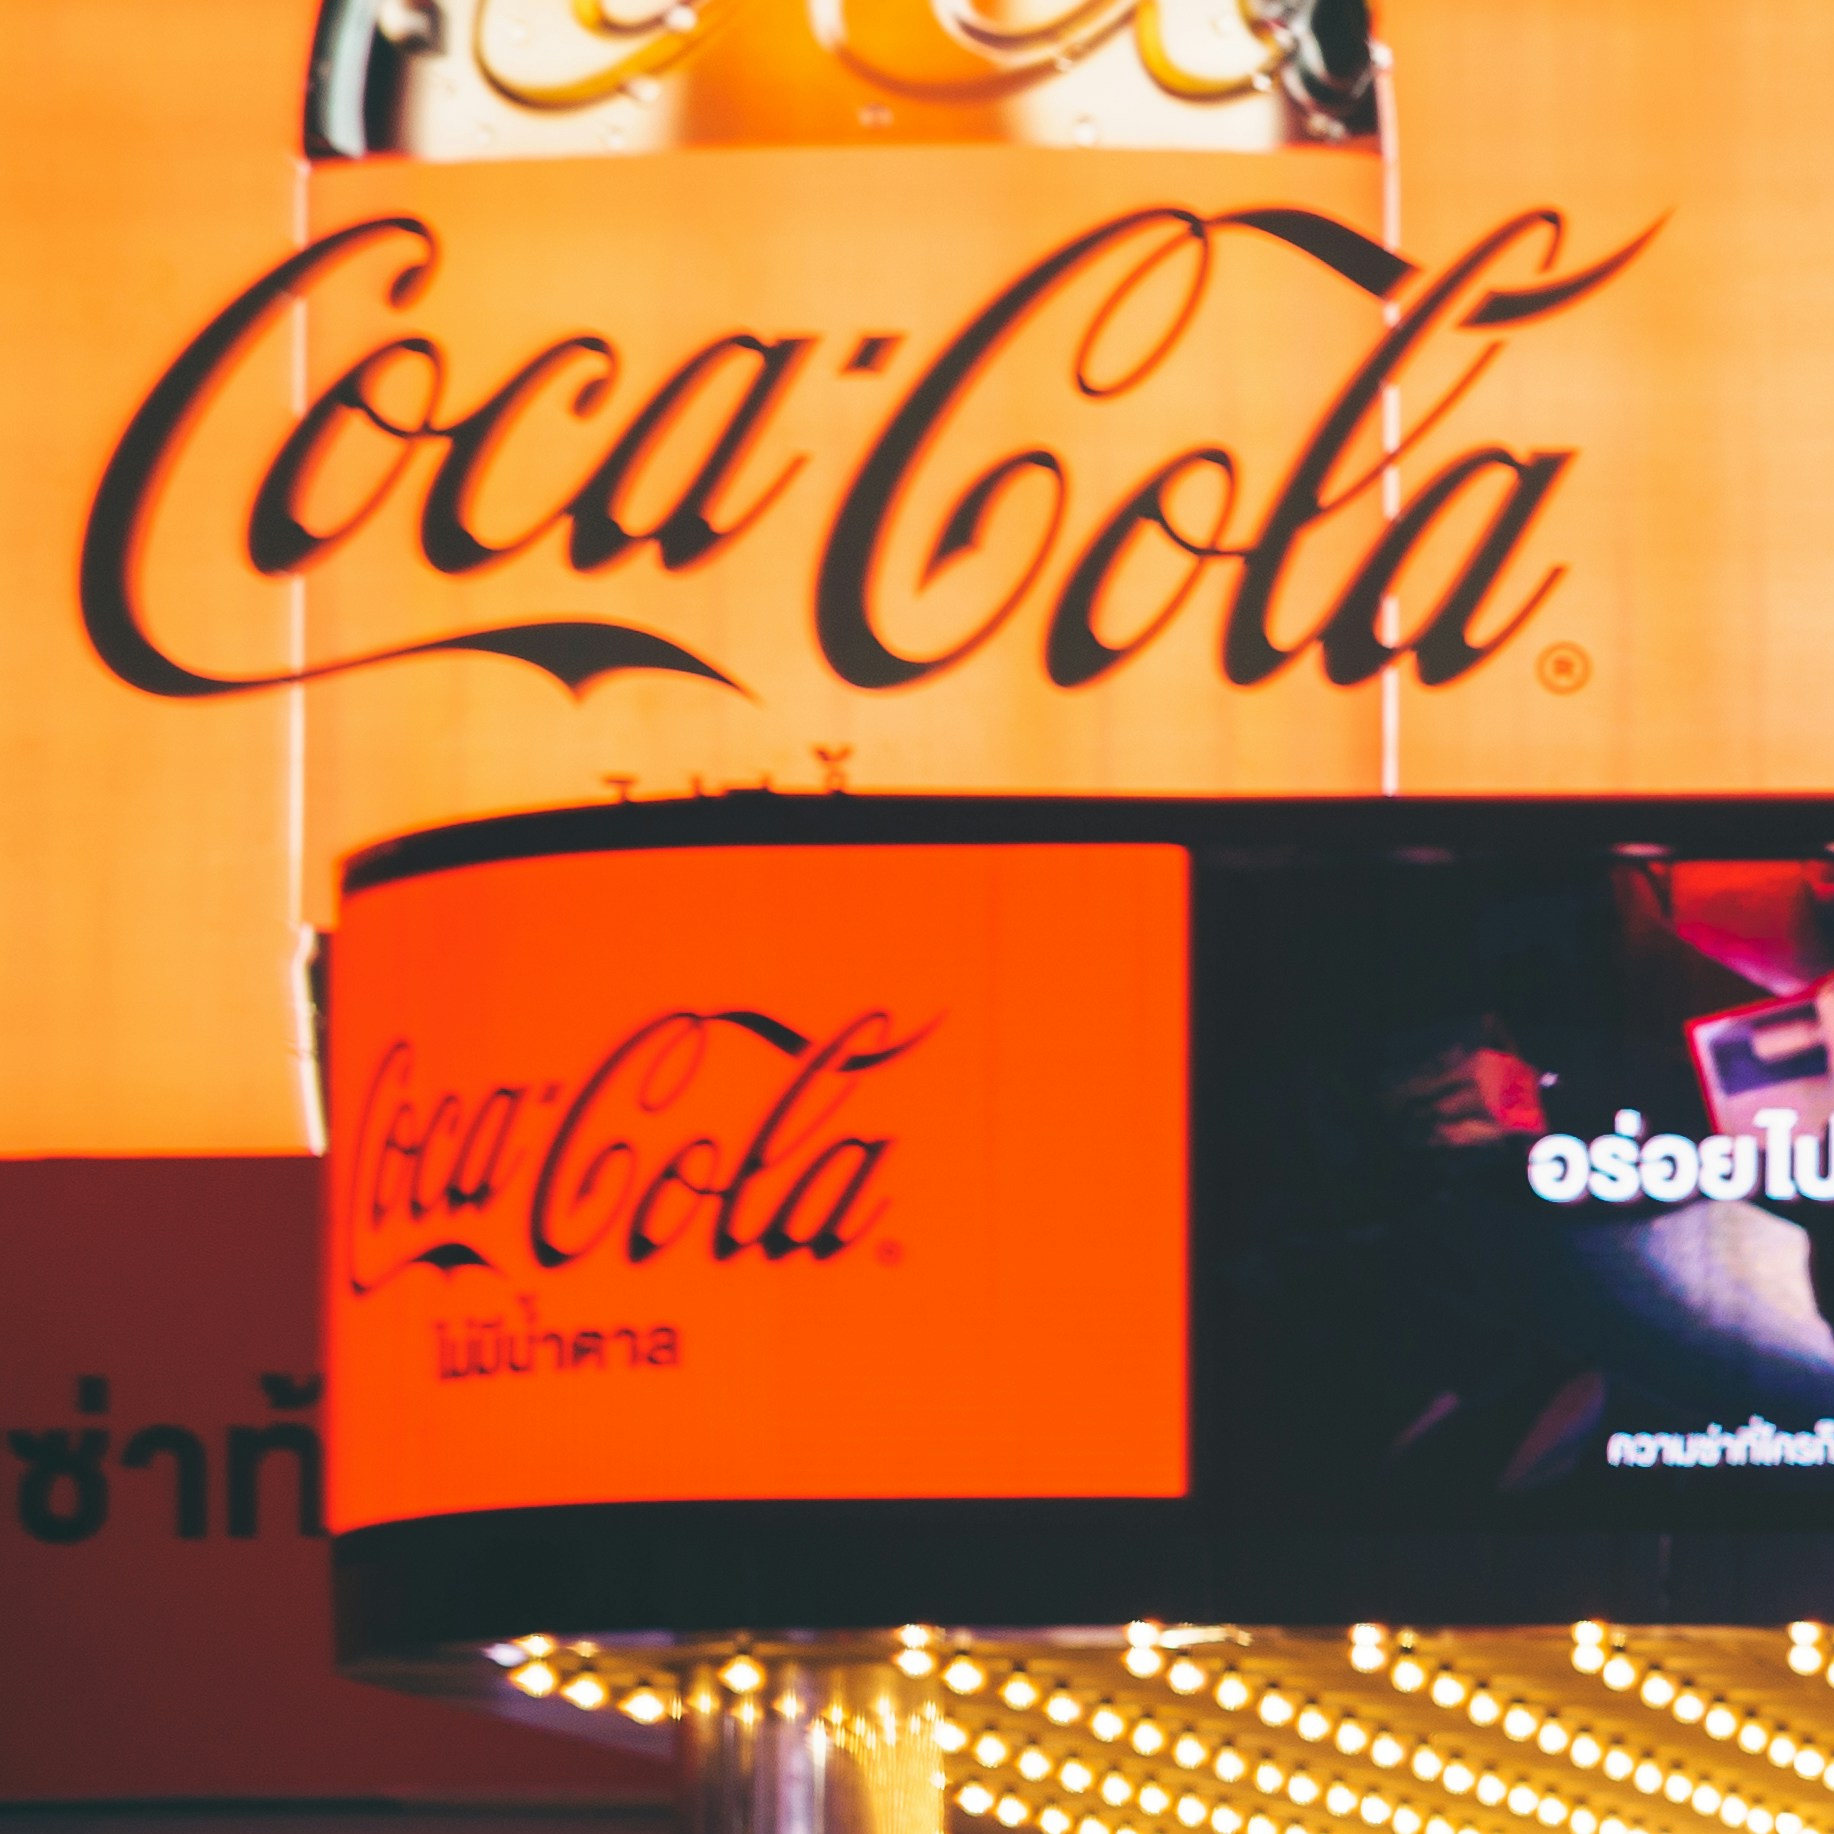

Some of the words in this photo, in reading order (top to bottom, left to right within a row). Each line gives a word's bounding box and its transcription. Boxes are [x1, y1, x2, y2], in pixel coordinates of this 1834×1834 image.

[78, 206, 1675, 702] Coca-Cola
[349, 1009, 948, 1295] Coca-Cola
[436, 1295, 682, 1381] ไม่มีน้ำตาล
